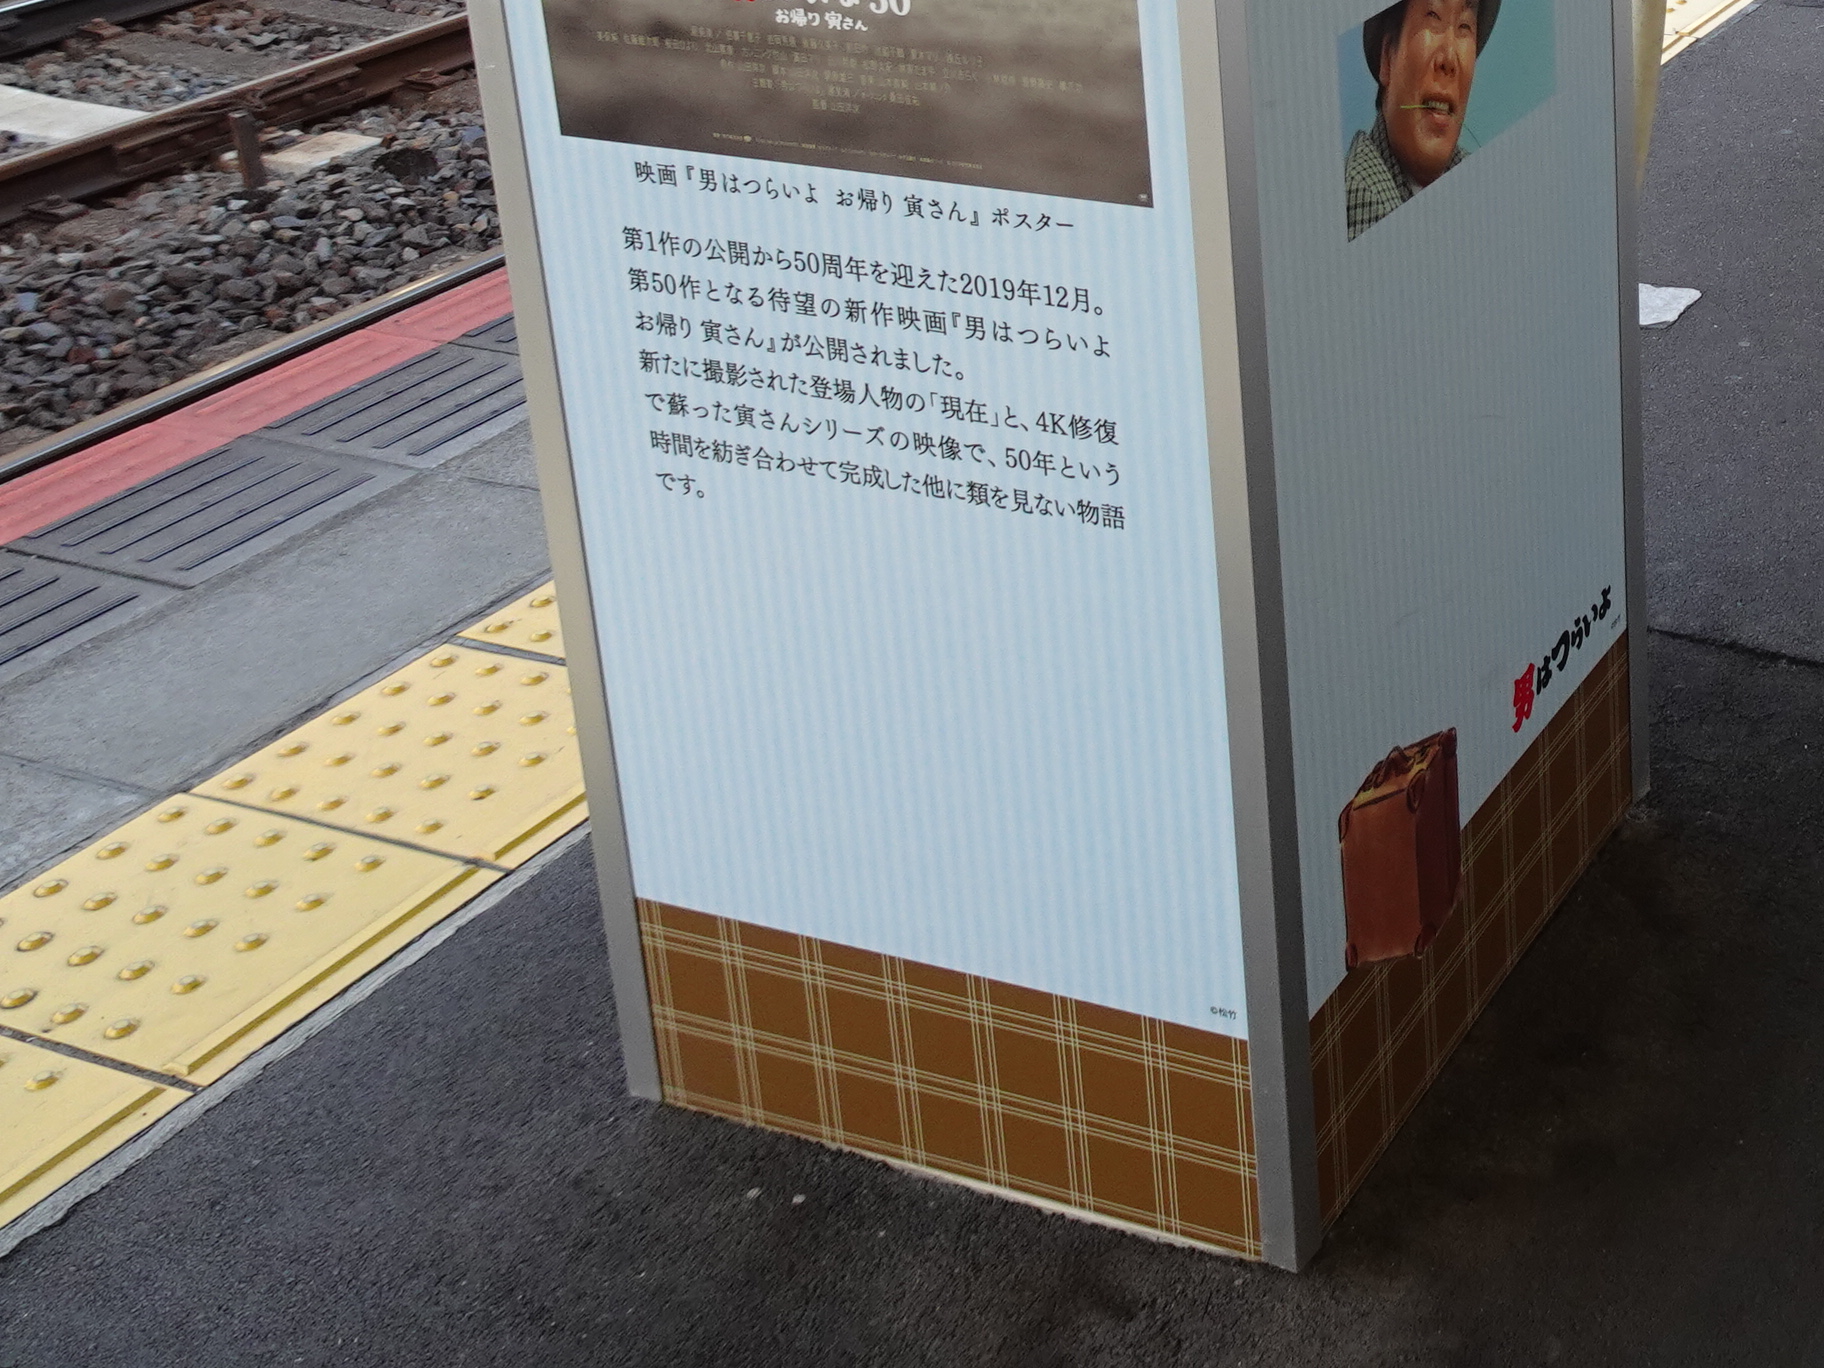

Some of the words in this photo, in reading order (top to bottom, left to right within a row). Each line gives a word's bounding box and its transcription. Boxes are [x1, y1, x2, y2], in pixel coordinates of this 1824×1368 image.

[622, 225, 1104, 317] 第1作の公開から50周年を迎えた2019年12月。
[627, 267, 1111, 358] 第50作となる待望の新作映画『男はつらいよ
[638, 348, 1119, 446] 新たに撮影された登場人物の「現在」と、4K修復
[645, 391, 1122, 487] で蘇った寅さんシリーズの映像で、50年という
[649, 430, 1126, 531] 時間を紡ぎ合わせて完成した他に類を見ない物語
[655, 471, 706, 500] です。
[1511, 584, 1612, 733] 男はつらいよ
